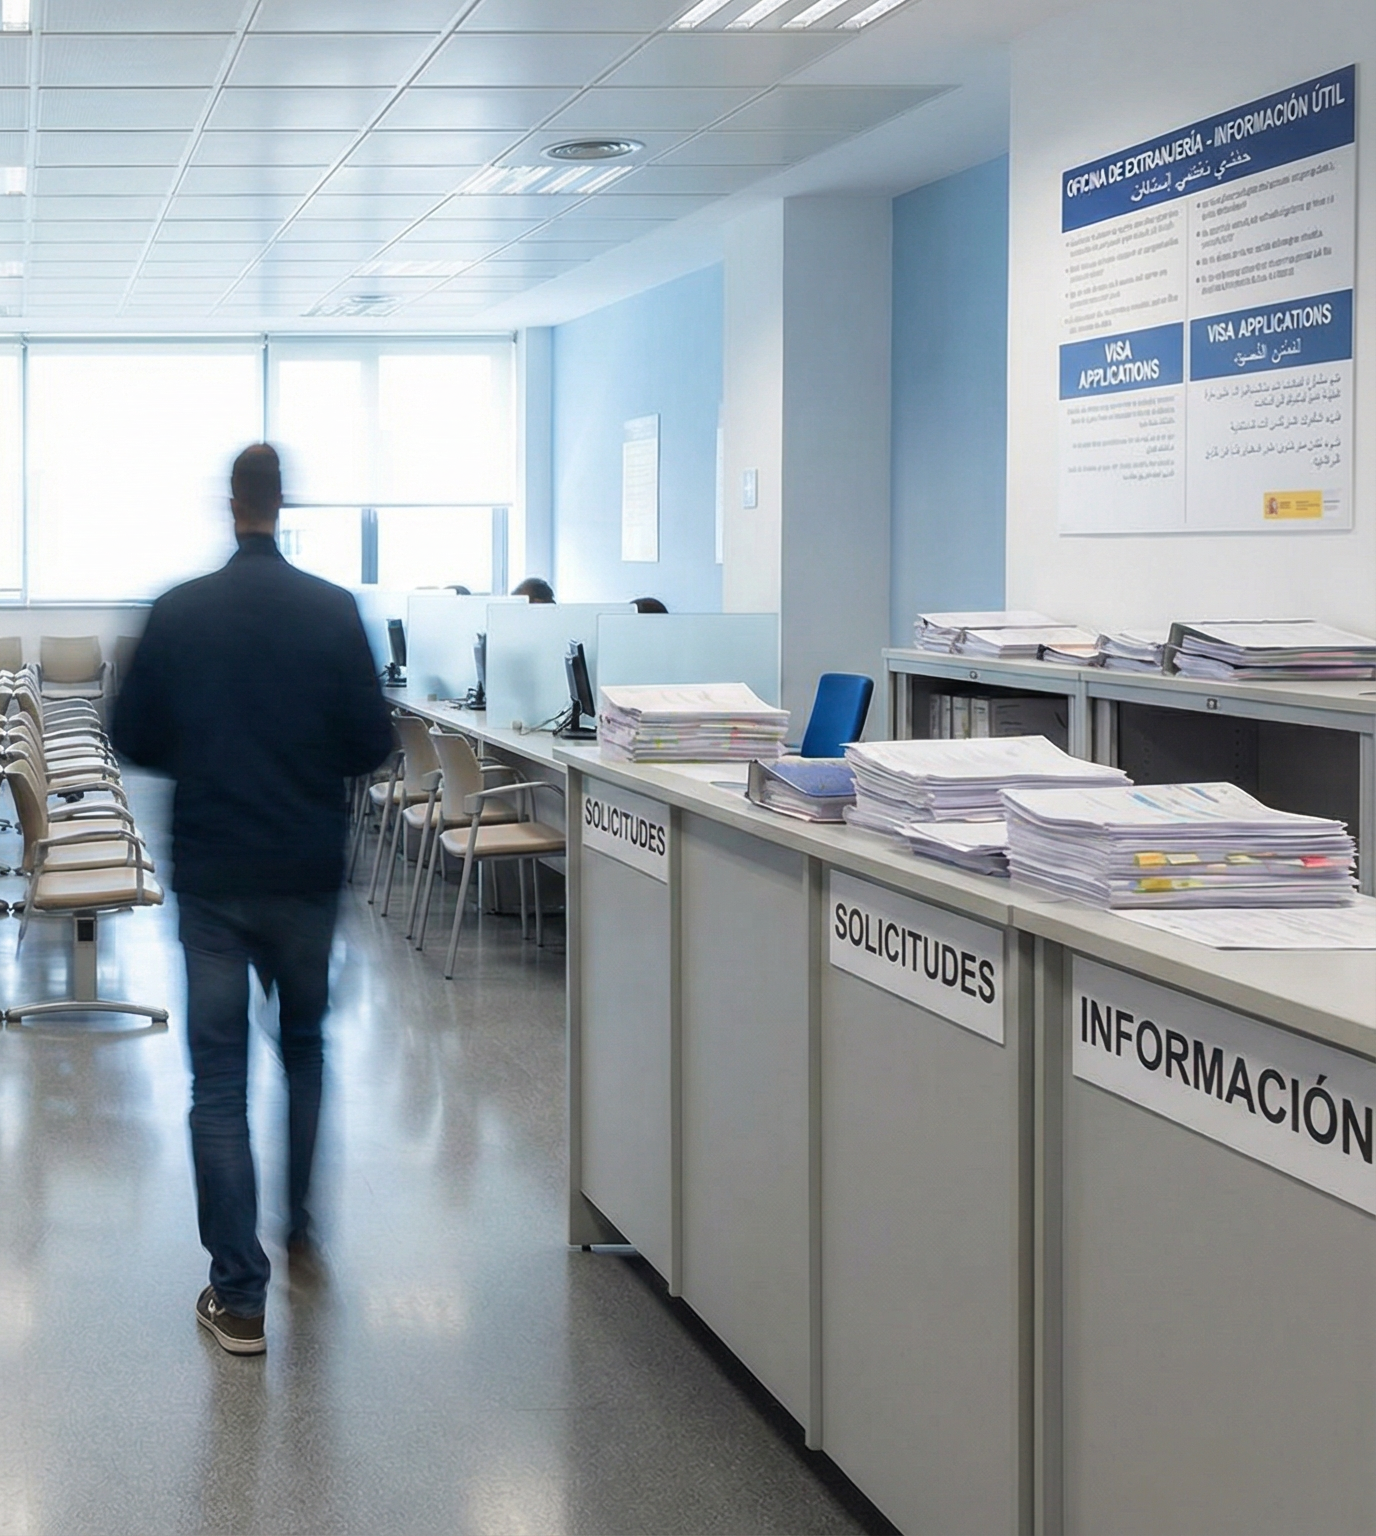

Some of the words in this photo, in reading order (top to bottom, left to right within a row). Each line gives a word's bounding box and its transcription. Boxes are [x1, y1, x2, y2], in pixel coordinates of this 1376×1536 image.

[1067, 168, 1107, 198] OFICINA
[1108, 161, 1124, 184] DE
[1125, 130, 1204, 178] EXTRANJERÍA
[1214, 92, 1309, 147] INFORMACIÓN
[1312, 83, 1346, 113] ÚTIL
[1105, 339, 1133, 364] VISA
[1207, 320, 1235, 343] VISA
[1238, 303, 1332, 339] APPLICATIONS
[1078, 358, 1160, 390] APPLICATIONS
[585, 797, 666, 856] SOLICITUDES
[835, 903, 995, 1004] SOLICITUDES
[1081, 996, 1373, 1164] INFORMACIÓN
